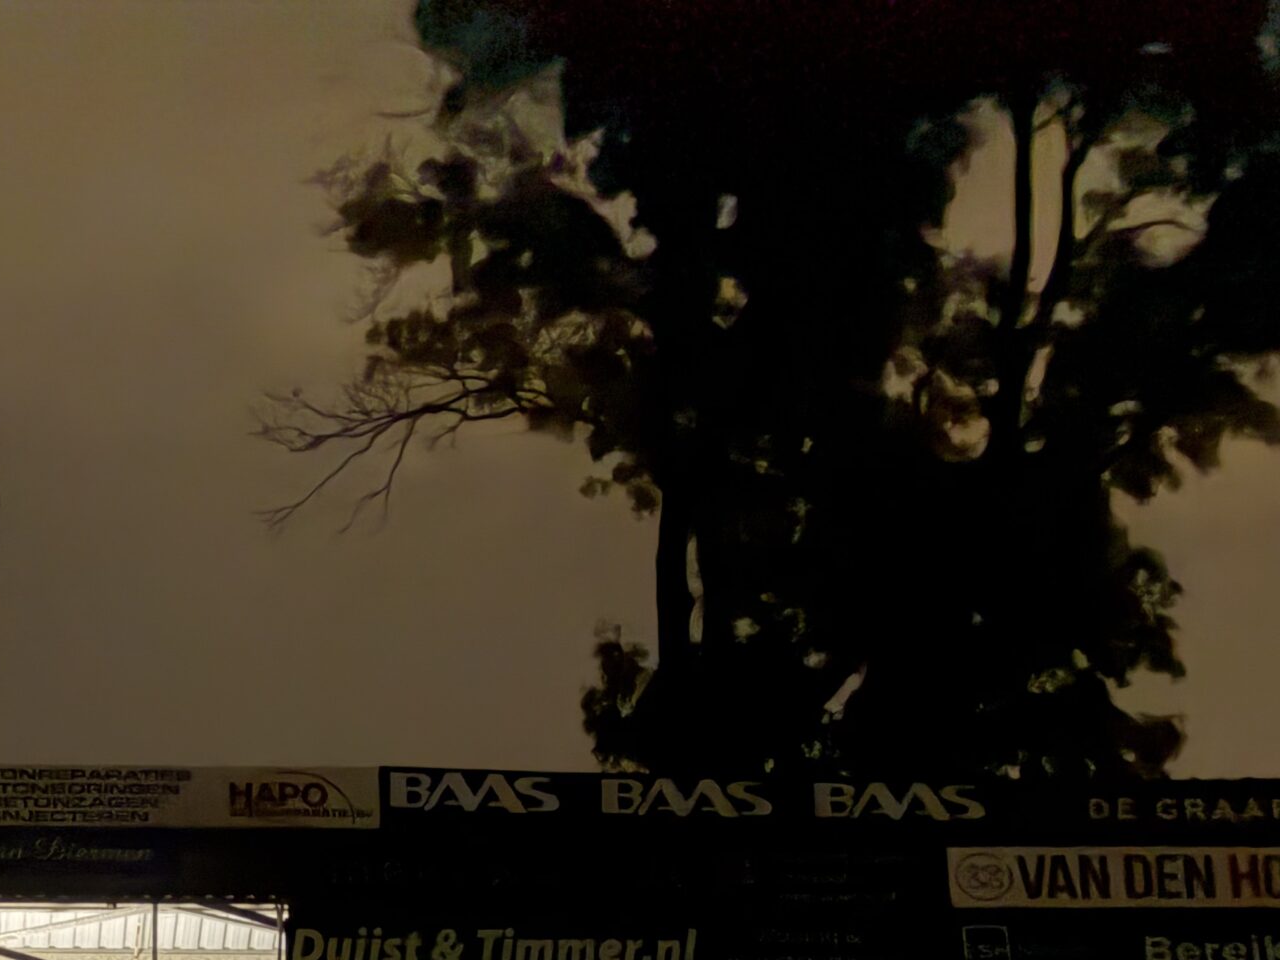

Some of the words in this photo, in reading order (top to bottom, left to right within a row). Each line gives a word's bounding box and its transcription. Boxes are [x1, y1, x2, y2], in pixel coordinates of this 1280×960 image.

[229, 782, 328, 807] HAPO
[389, 772, 560, 813] BAAS
[601, 777, 772, 818] BAAS
[814, 782, 986, 821] BAAS
[1088, 797, 1137, 820] DE
[1017, 855, 1112, 899] VAN
[1123, 855, 1216, 899] DEN
